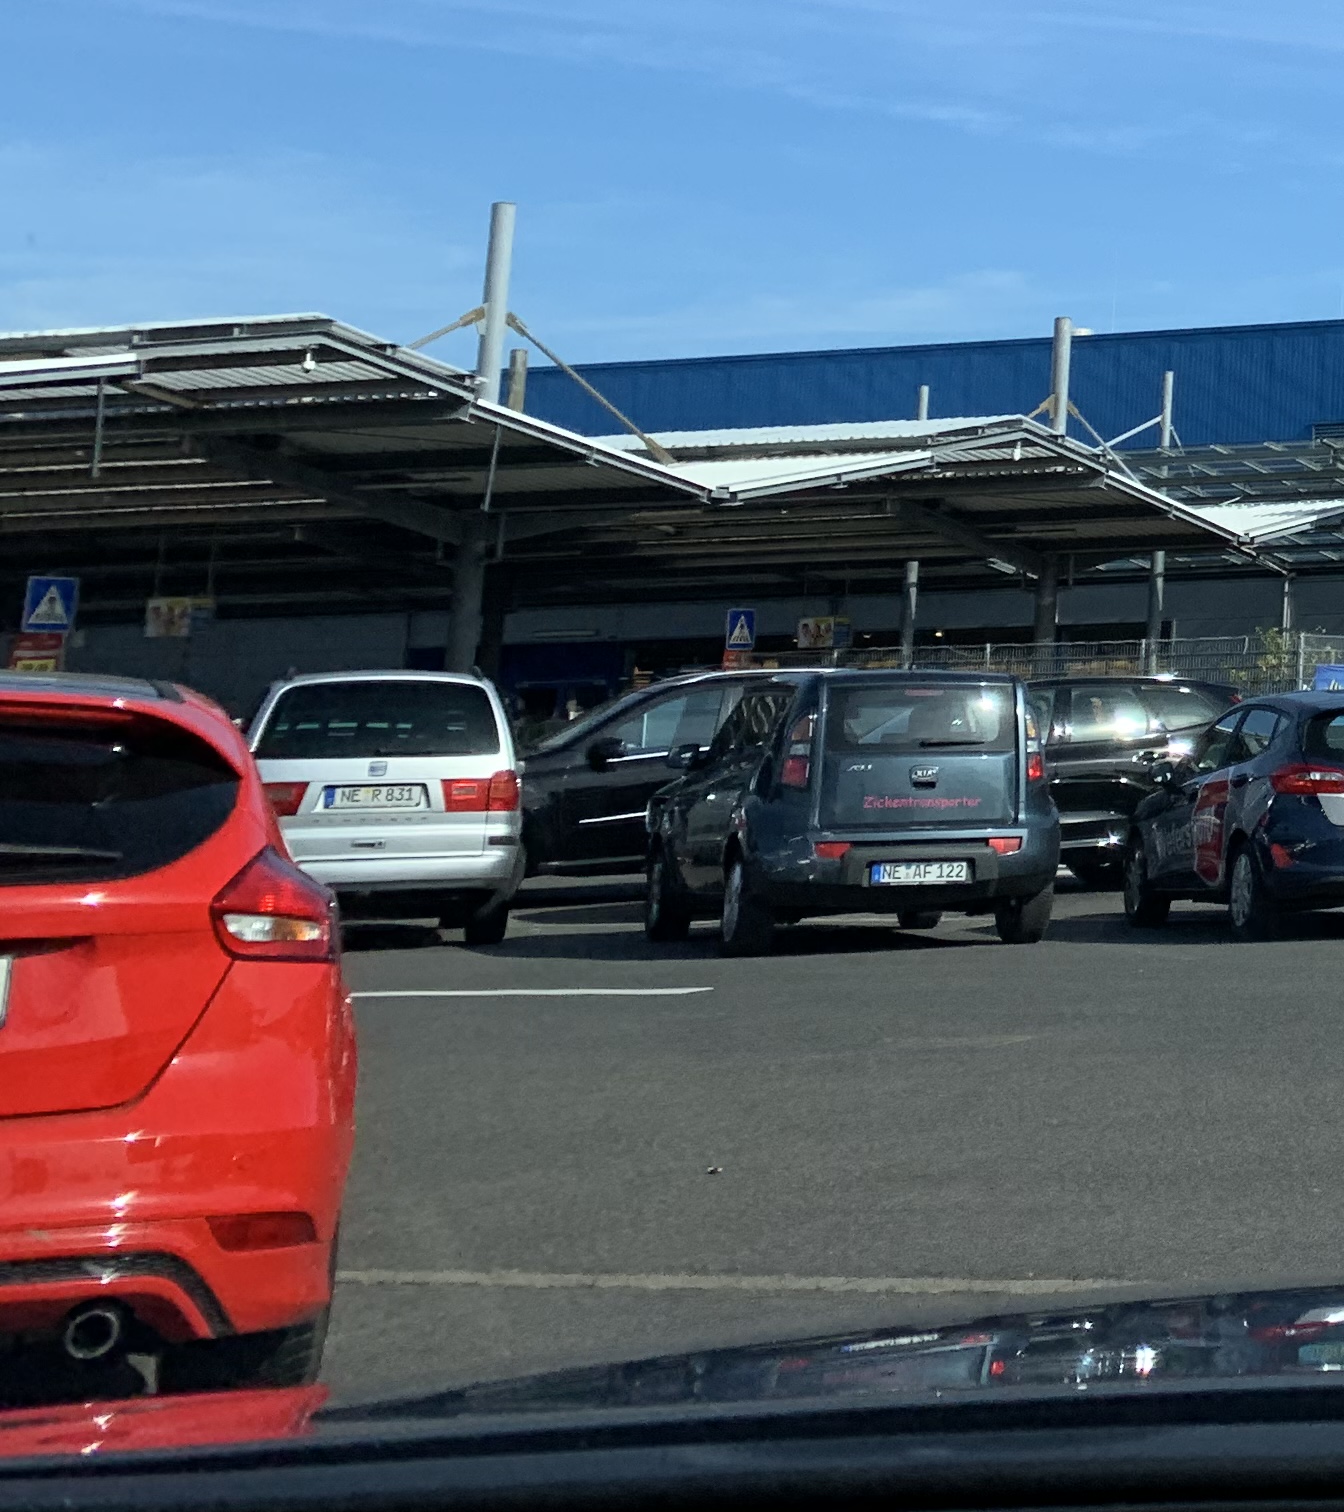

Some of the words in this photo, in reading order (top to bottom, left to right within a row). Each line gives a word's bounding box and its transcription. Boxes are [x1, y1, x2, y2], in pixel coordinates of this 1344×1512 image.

[340, 789, 361, 803] NE
[371, 788, 382, 802] R
[385, 787, 414, 802] 831
[863, 796, 982, 810] Zickentransporter
[882, 864, 902, 880] NE
[912, 863, 933, 879] AF
[936, 863, 965, 879] 122
